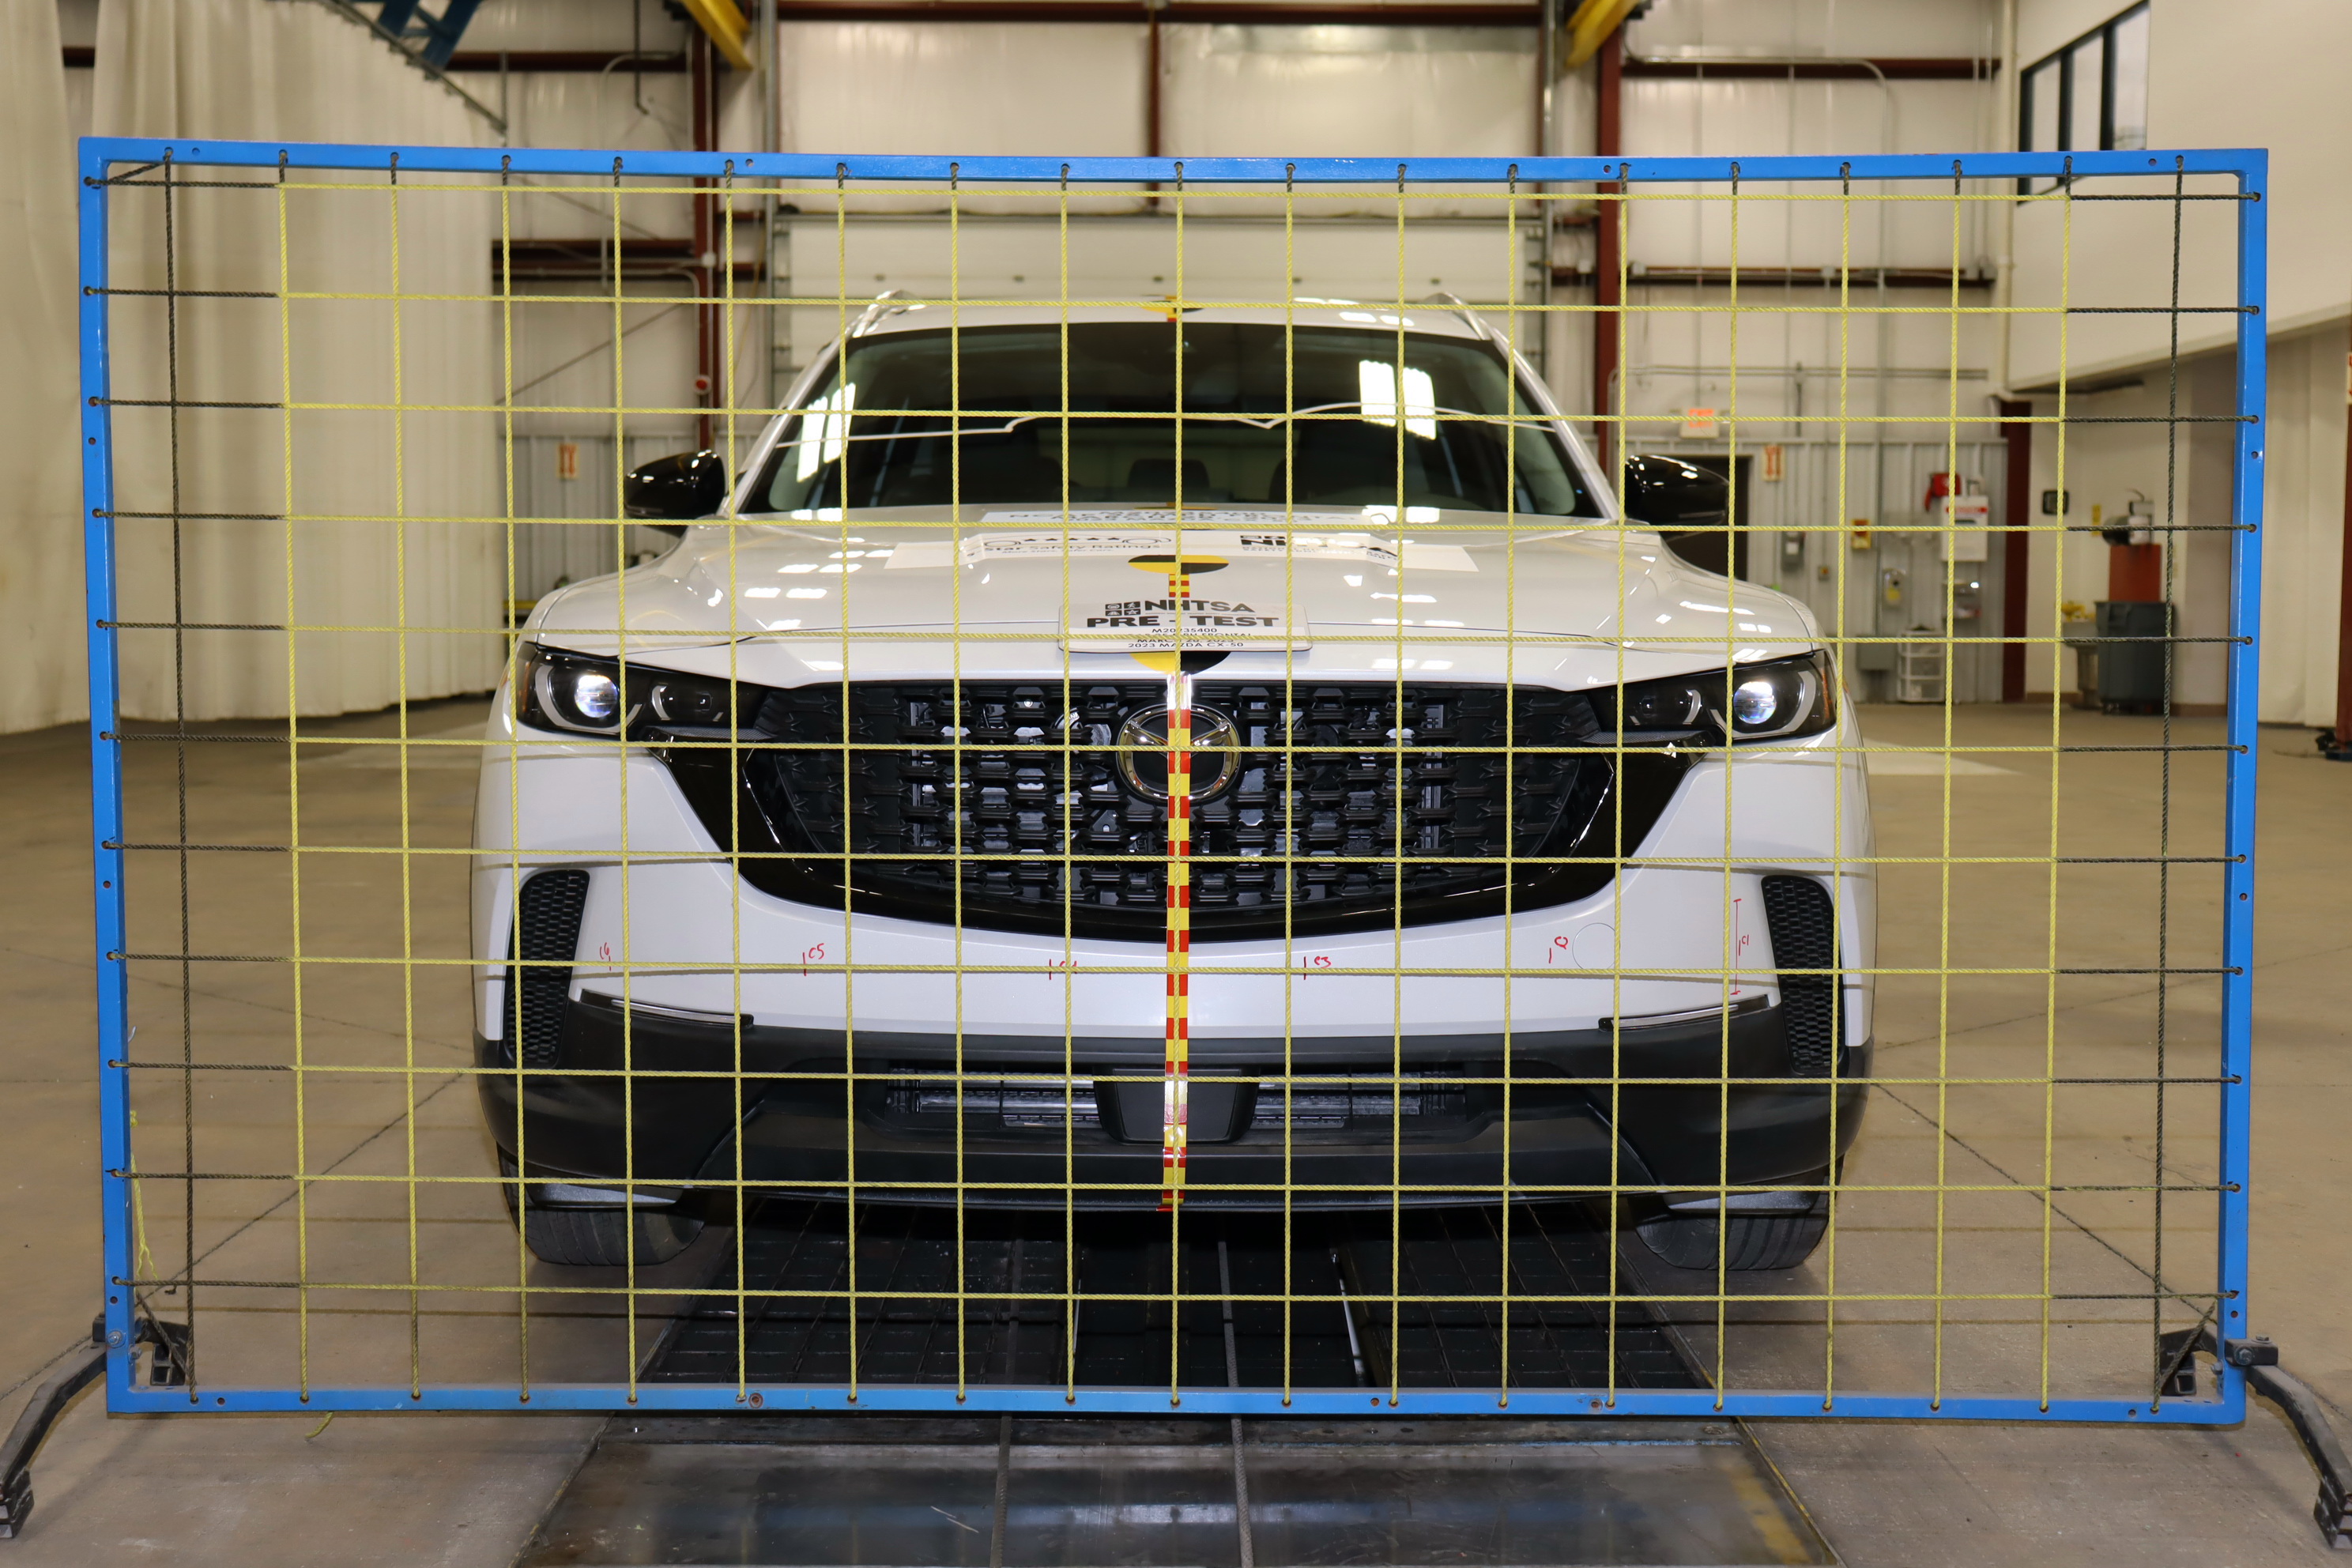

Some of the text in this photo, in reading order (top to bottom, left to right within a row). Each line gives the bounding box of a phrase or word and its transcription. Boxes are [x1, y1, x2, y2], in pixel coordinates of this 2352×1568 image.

[1145, 599, 1255, 612] NHTSA
[1087, 616, 1160, 628] PRE
[1189, 616, 1279, 627] TEST
